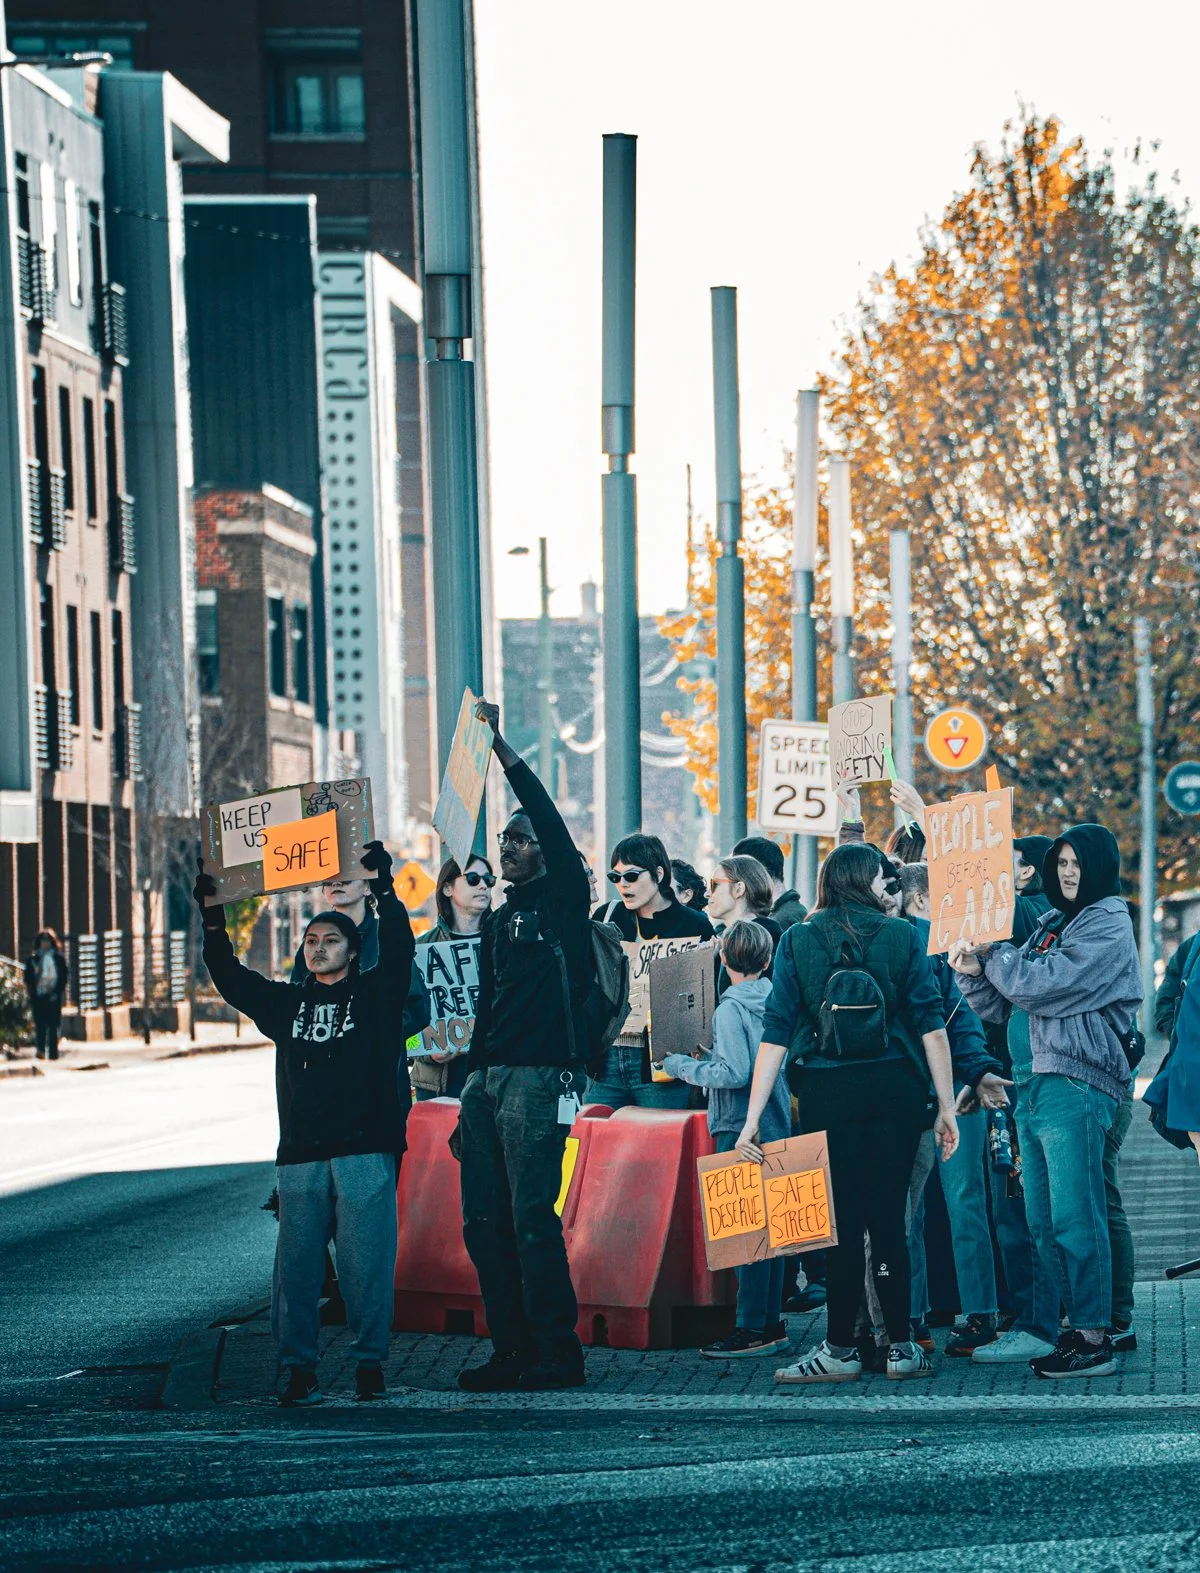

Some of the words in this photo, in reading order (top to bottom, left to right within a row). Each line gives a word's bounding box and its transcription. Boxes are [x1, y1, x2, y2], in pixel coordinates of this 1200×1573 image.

[834, 732, 885, 758] NORING
[775, 759, 827, 776] LIMIT
[222, 801, 272, 832] KEEP
[773, 784, 826, 819] 25
[243, 828, 268, 848] US
[929, 800, 1004, 862] PEOPLE
[274, 836, 330, 872] SAFE
[947, 858, 989, 889] BEFORE
[937, 870, 1011, 948] CARS
[421, 943, 480, 985] AF
[706, 1164, 758, 1201] PEOPLE
[770, 1171, 825, 1212] SAFE
[710, 1195, 763, 1236] DESERVE
[770, 1202, 828, 1239] STREETS
